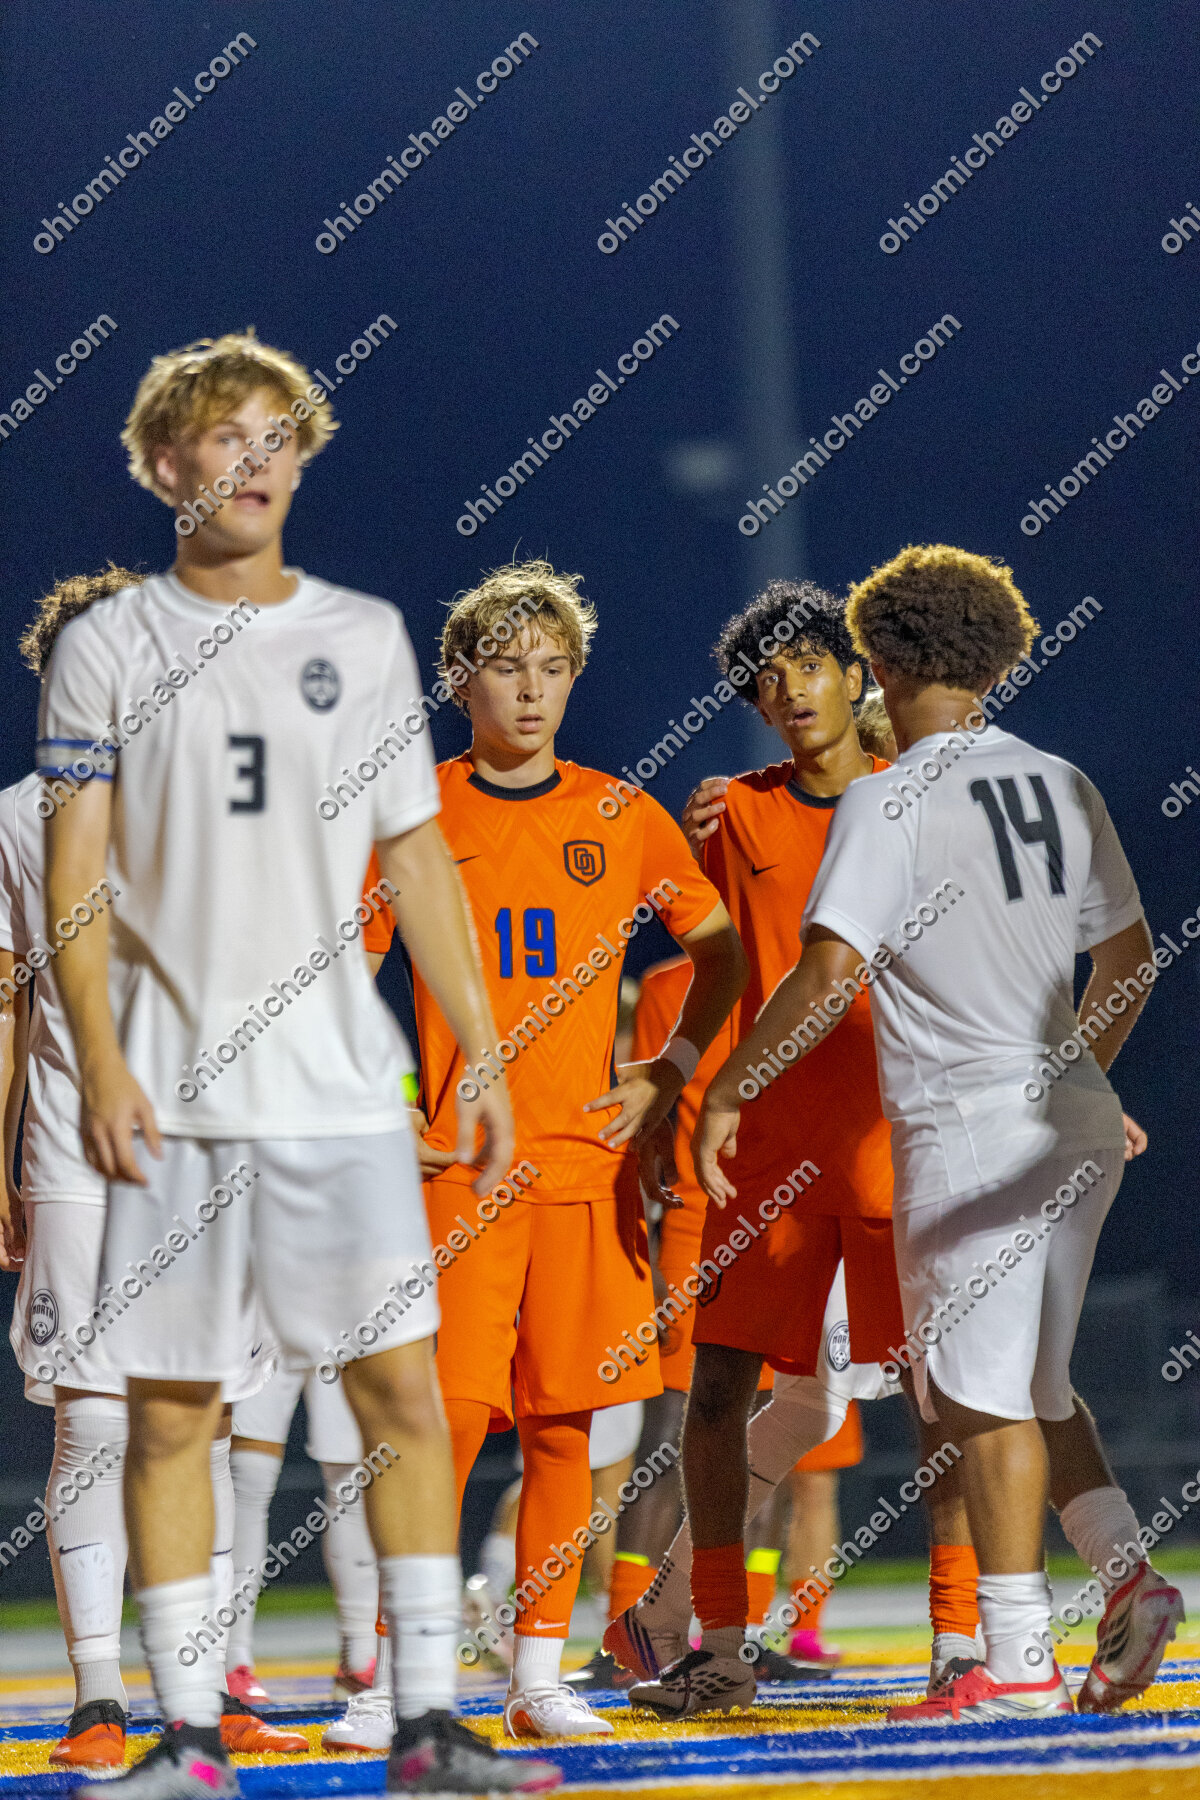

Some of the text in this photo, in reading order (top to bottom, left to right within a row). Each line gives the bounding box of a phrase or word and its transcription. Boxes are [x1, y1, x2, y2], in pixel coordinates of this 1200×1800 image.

[227, 733, 266, 815] 3
[969, 772, 1066, 902] 14
[494, 907, 557, 978] 19
[832, 1334, 849, 1345] NOR
